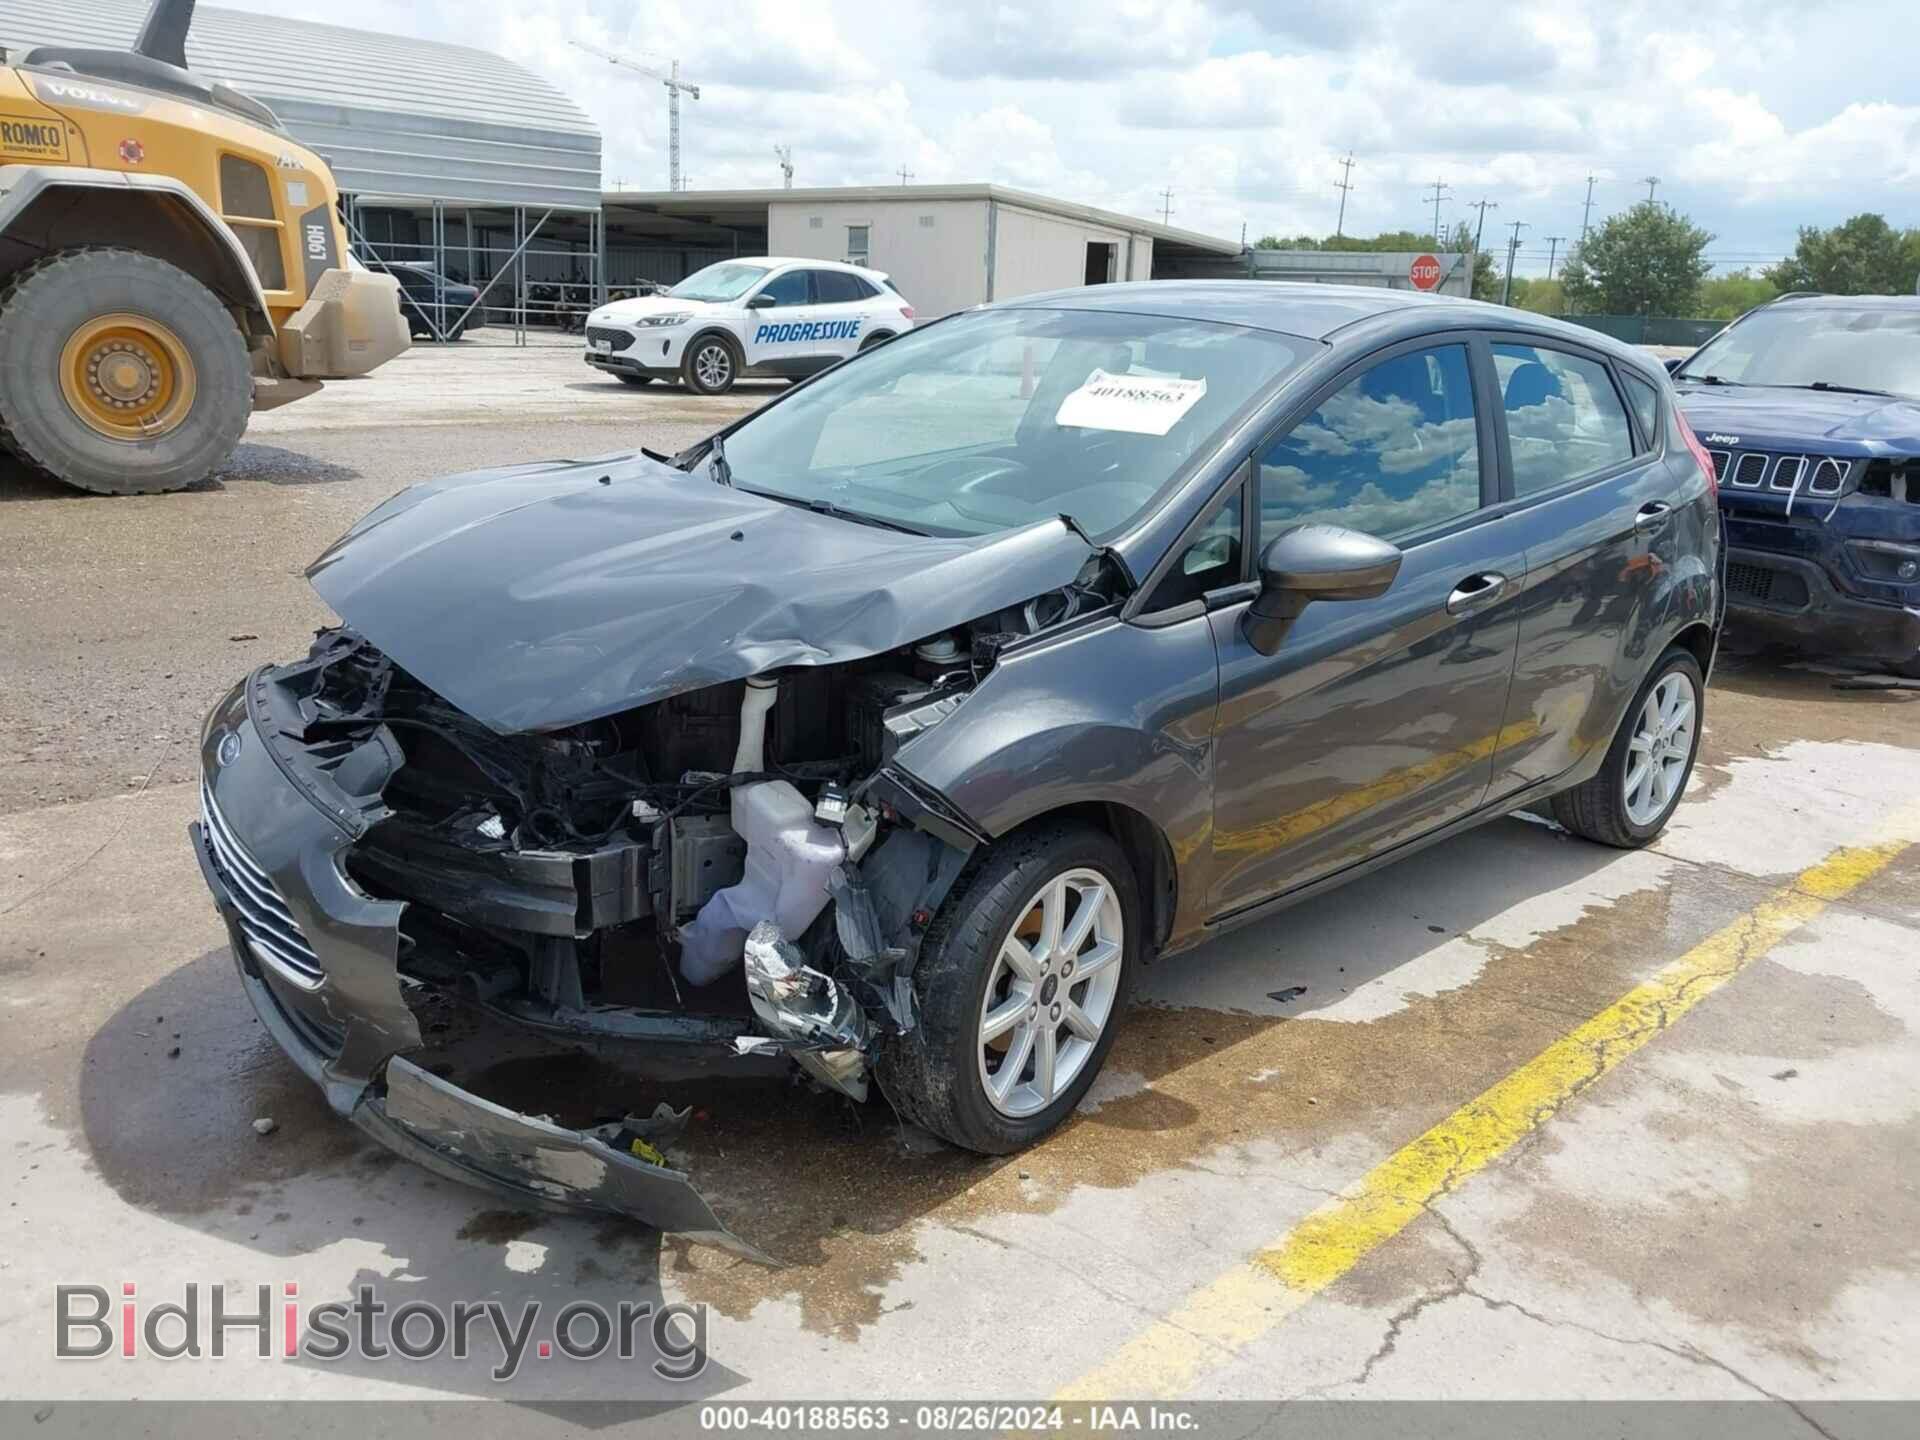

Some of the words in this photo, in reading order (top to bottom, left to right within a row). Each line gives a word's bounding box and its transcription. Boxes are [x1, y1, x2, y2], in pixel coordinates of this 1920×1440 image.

[1, 121, 60, 147] ROMCO
[306, 225, 327, 260] L90H
[1412, 265, 1439, 279] STOP
[754, 319, 862, 344] PROGRESSIVE
[1705, 432, 1739, 446] Jeep
